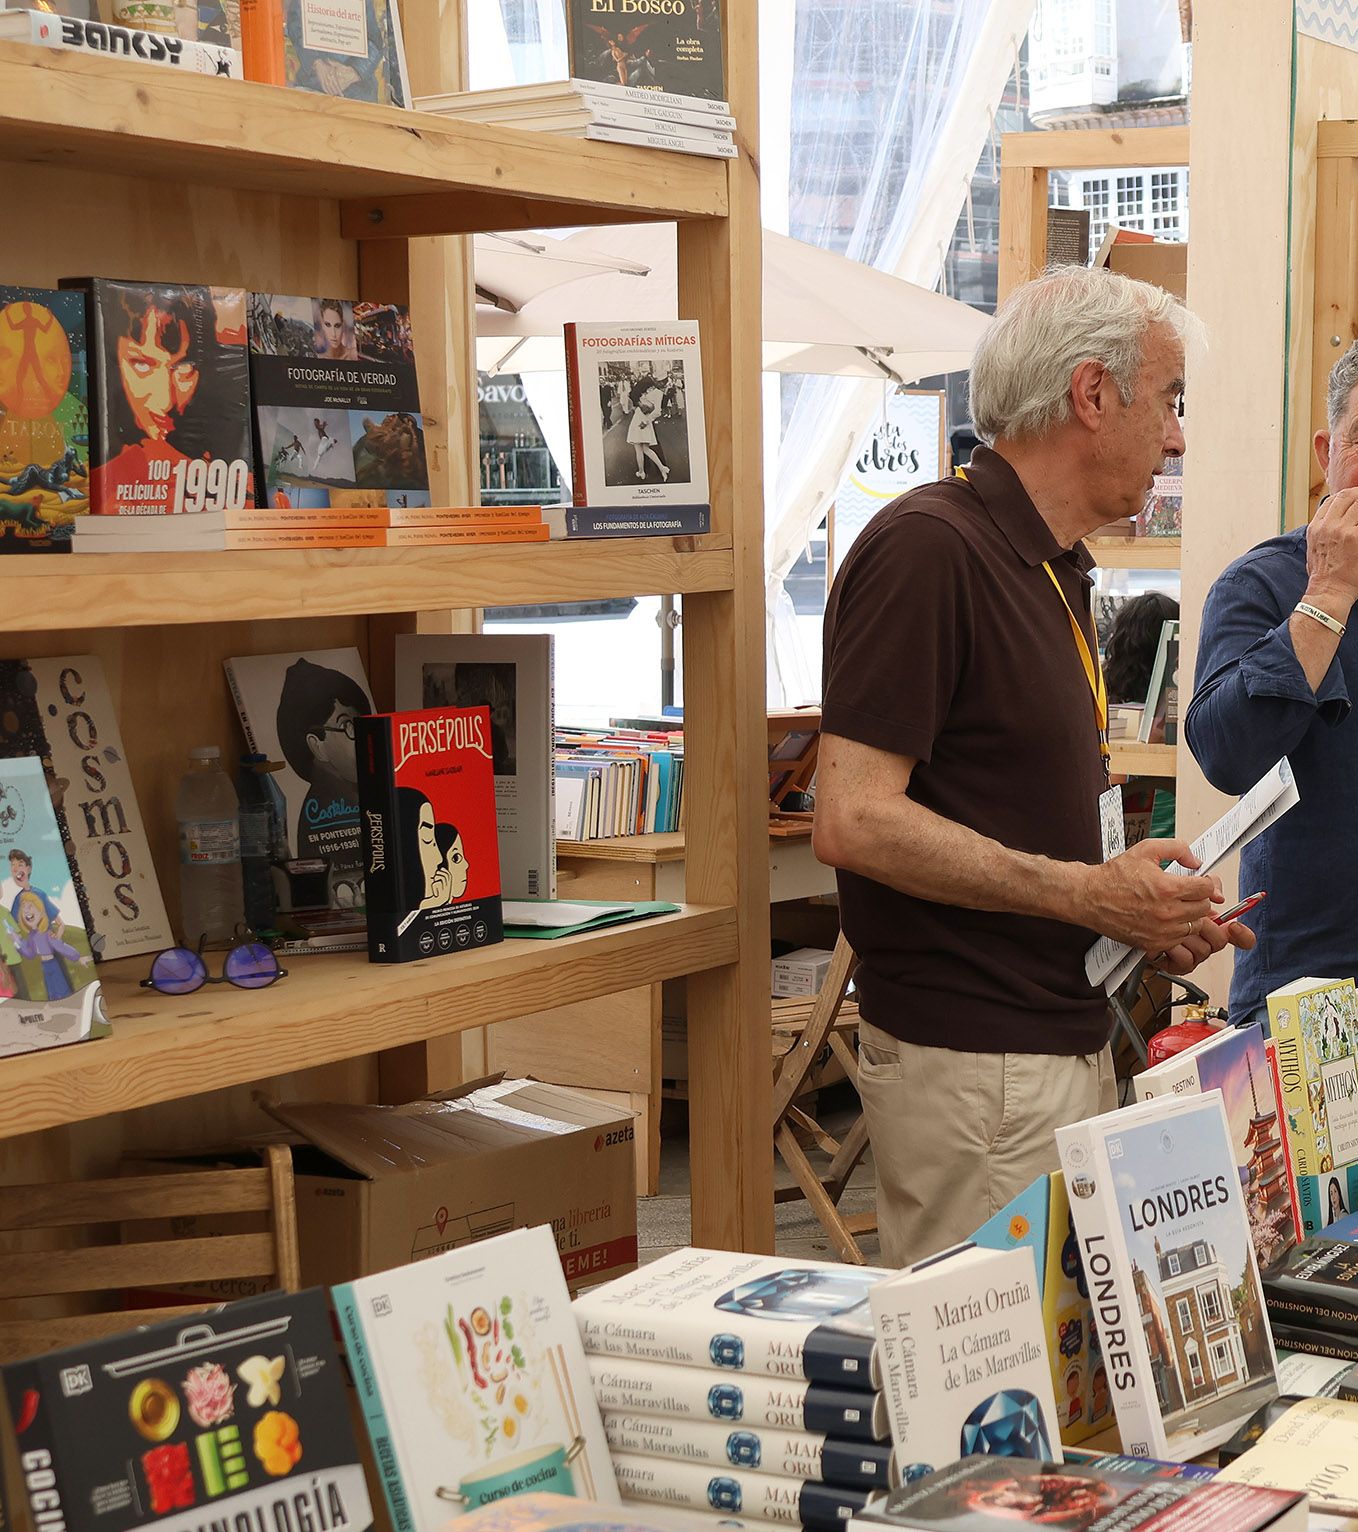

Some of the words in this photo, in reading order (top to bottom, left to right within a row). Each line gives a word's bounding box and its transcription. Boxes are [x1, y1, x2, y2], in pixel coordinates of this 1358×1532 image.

[307, 3, 335, 18] Historia
[349, 12, 361, 21] arte
[676, 46, 704, 54] completa
[582, 335, 653, 347] FOTOGRAFÍAS
[655, 333, 696, 346] MÍTICAS
[288, 368, 344, 384] FOTOGRAFÍA
[346, 371, 358, 384] DE
[359, 372, 397, 386] VERDAD
[117, 479, 168, 501] PELÍCULAS
[148, 459, 170, 481] 100
[172, 458, 248, 514] 1990
[593, 522, 602, 530] LOS
[603, 521, 640, 530] FUNDAMENTOS
[641, 521, 646, 529] DE
[647, 521, 653, 529] LA
[653, 519, 682, 529] FOTOGRAFÍA
[397, 715, 488, 762] PERSÉPOLIS
[308, 834, 320, 843] EN
[366, 810, 386, 873] PERSÉPOLIS
[1278, 1035, 1302, 1094] MYTHOS
[1172, 1076, 1195, 1095] DESTINO
[1325, 1068, 1358, 1104] MYTHOS
[605, 1125, 634, 1147] azeta
[568, 1202, 611, 1227] librería
[1129, 1176, 1230, 1232] LONDRES
[1305, 1221, 1314, 1231] B
[209, 1280, 257, 1296] cerca
[375, 1300, 389, 1313] DK
[934, 1296, 982, 1331] María
[985, 1281, 1032, 1311] Oruña
[1084, 1235, 1136, 1392] LONDRES
[1267, 1299, 1313, 1313] MONSTRUO
[1314, 1307, 1331, 1317] DEL
[345, 1305, 358, 1343] Curso
[585, 1320, 602, 1334] La
[604, 1321, 655, 1341] Cámara
[881, 1314, 893, 1332] de
[897, 1312, 912, 1333] La
[353, 1344, 362, 1356] de
[605, 1339, 623, 1352] las
[626, 1340, 693, 1362] Maravillas
[884, 1336, 895, 1359] las
[940, 1345, 958, 1365] La
[961, 1328, 1012, 1357] Cámara
[1273, 1337, 1320, 1352] MONSTRUO
[1321, 1345, 1336, 1355] DEL
[356, 1357, 374, 1397] cocina
[900, 1335, 919, 1399] Cámara
[944, 1372, 961, 1393] de
[965, 1364, 982, 1385] las
[985, 1341, 1042, 1377] Maravillas
[68, 1371, 88, 1389] DK
[600, 1371, 652, 1391] Cámara
[622, 1391, 690, 1413] Maravillas
[887, 1361, 909, 1443] Maravillas
[621, 1416, 673, 1437] Cámara
[620, 1434, 638, 1448] las
[642, 1437, 709, 1459] Maravillas
[785, 1440, 822, 1457] MAR
[1134, 1445, 1147, 1456] DK
[480, 1482, 509, 1504] Curso
[511, 1478, 523, 1492] de
[525, 1466, 557, 1488] cocina
[624, 1482, 691, 1503] Maravillas
